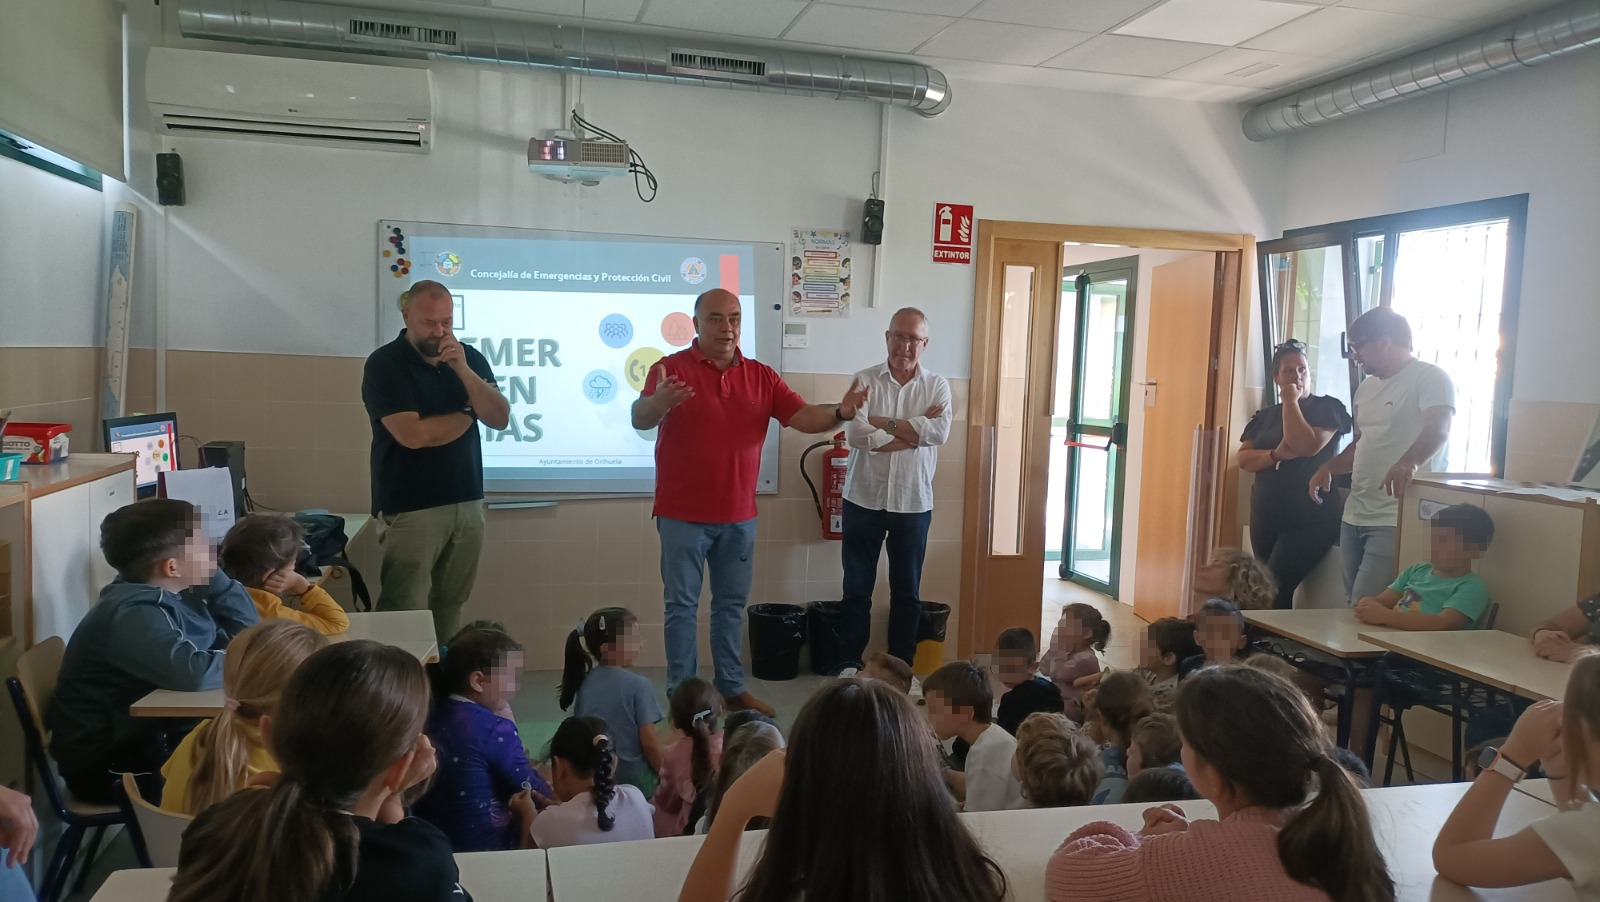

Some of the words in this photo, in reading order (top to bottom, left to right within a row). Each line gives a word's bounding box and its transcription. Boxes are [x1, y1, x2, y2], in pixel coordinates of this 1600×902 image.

[934, 250, 970, 260] EXTINTOR
[470, 269, 519, 280] Concejalía
[520, 271, 533, 280] de
[533, 271, 592, 282] Emergencias
[593, 274, 599, 283] y
[601, 272, 650, 283] Protección
[651, 273, 671, 283] Civil
[480, 412, 544, 443] IAS
[538, 458, 584, 466] Ayuntamiento
